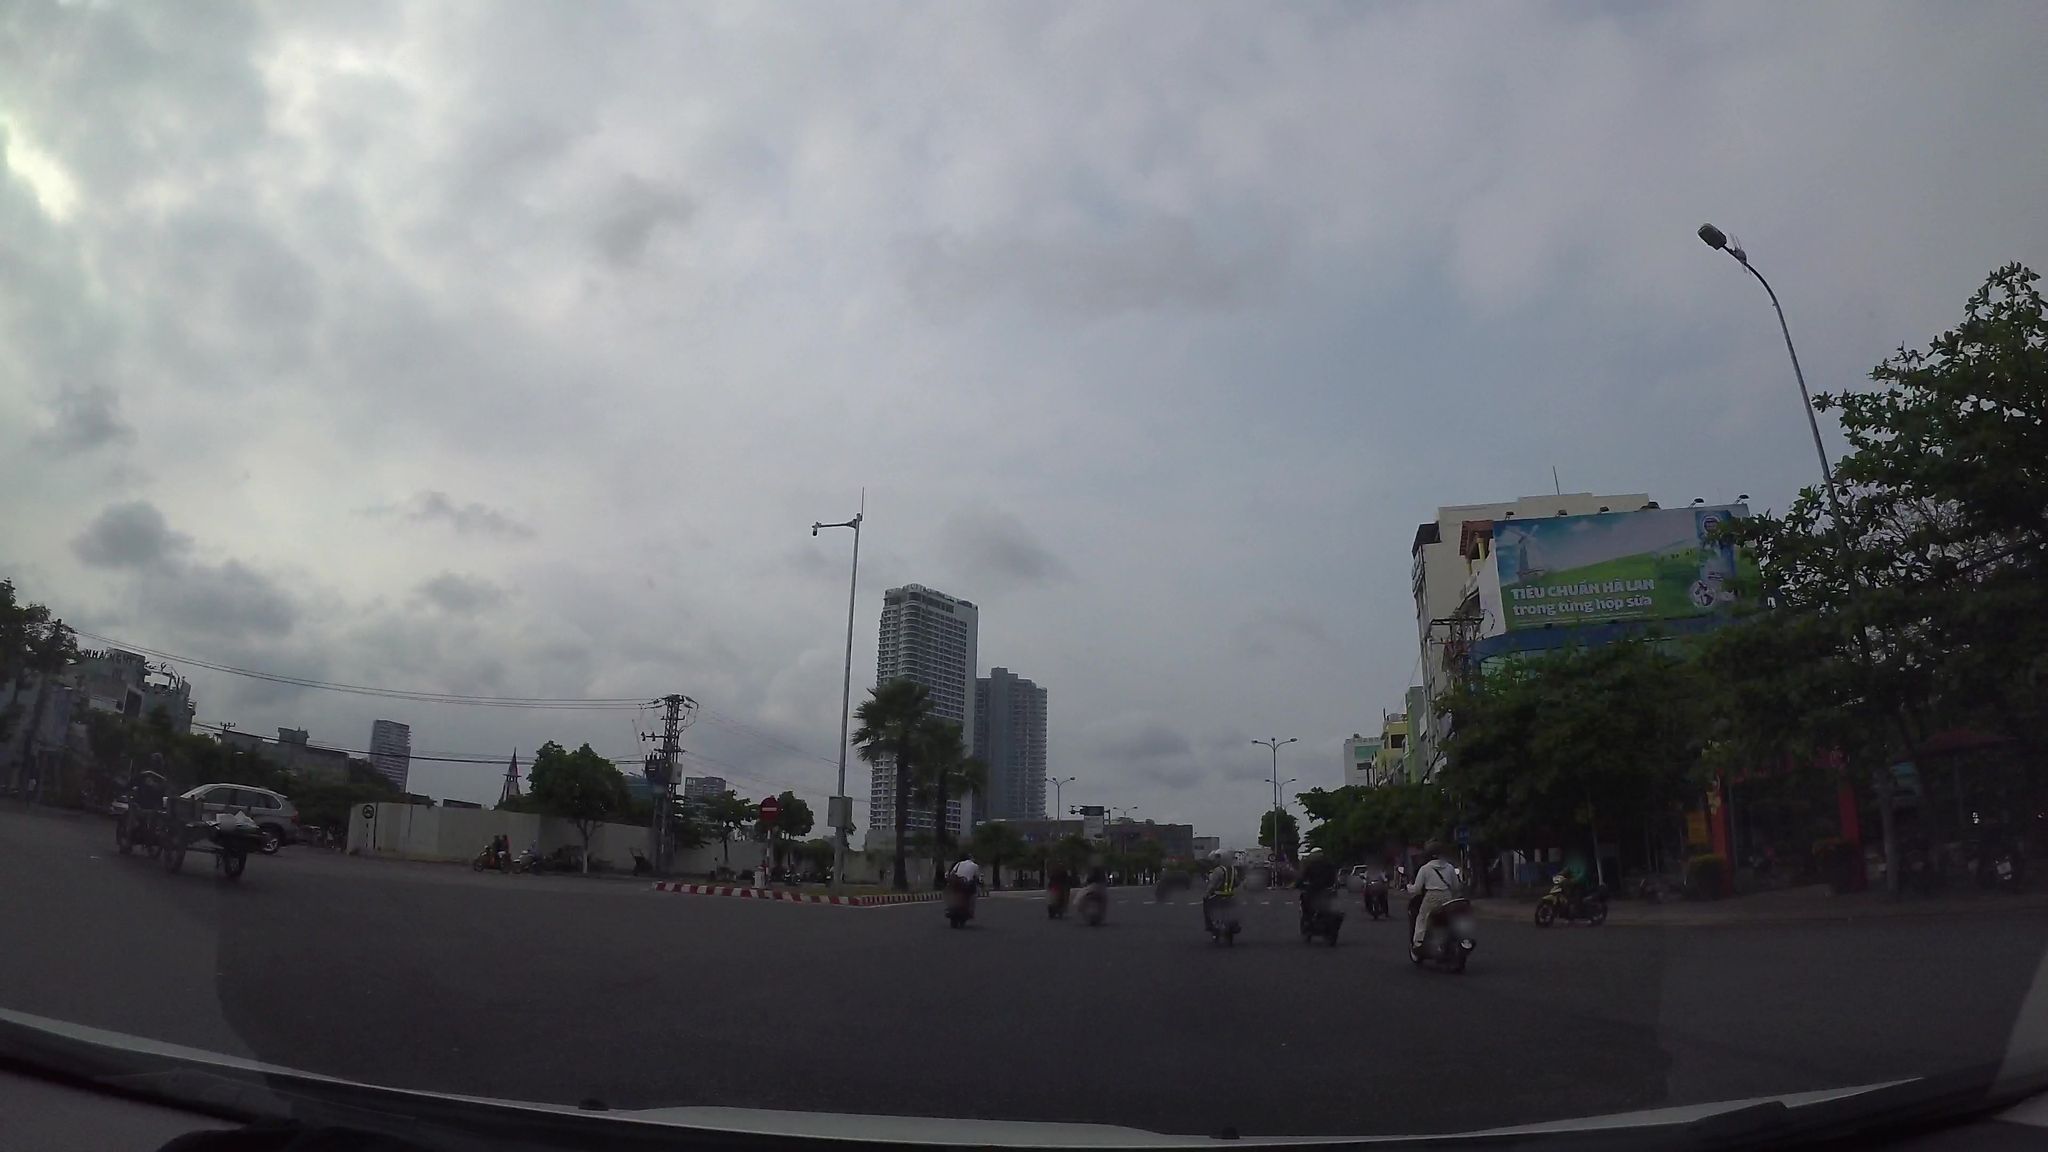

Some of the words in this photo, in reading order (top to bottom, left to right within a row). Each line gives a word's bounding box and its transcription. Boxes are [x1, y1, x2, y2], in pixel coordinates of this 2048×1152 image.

[1511, 585, 1545, 599] TIÊU
[1602, 578, 1624, 593] HÀ
[1626, 578, 1655, 591] LAN
[1513, 603, 1556, 616] trong
[1595, 597, 1624, 611] hộp
